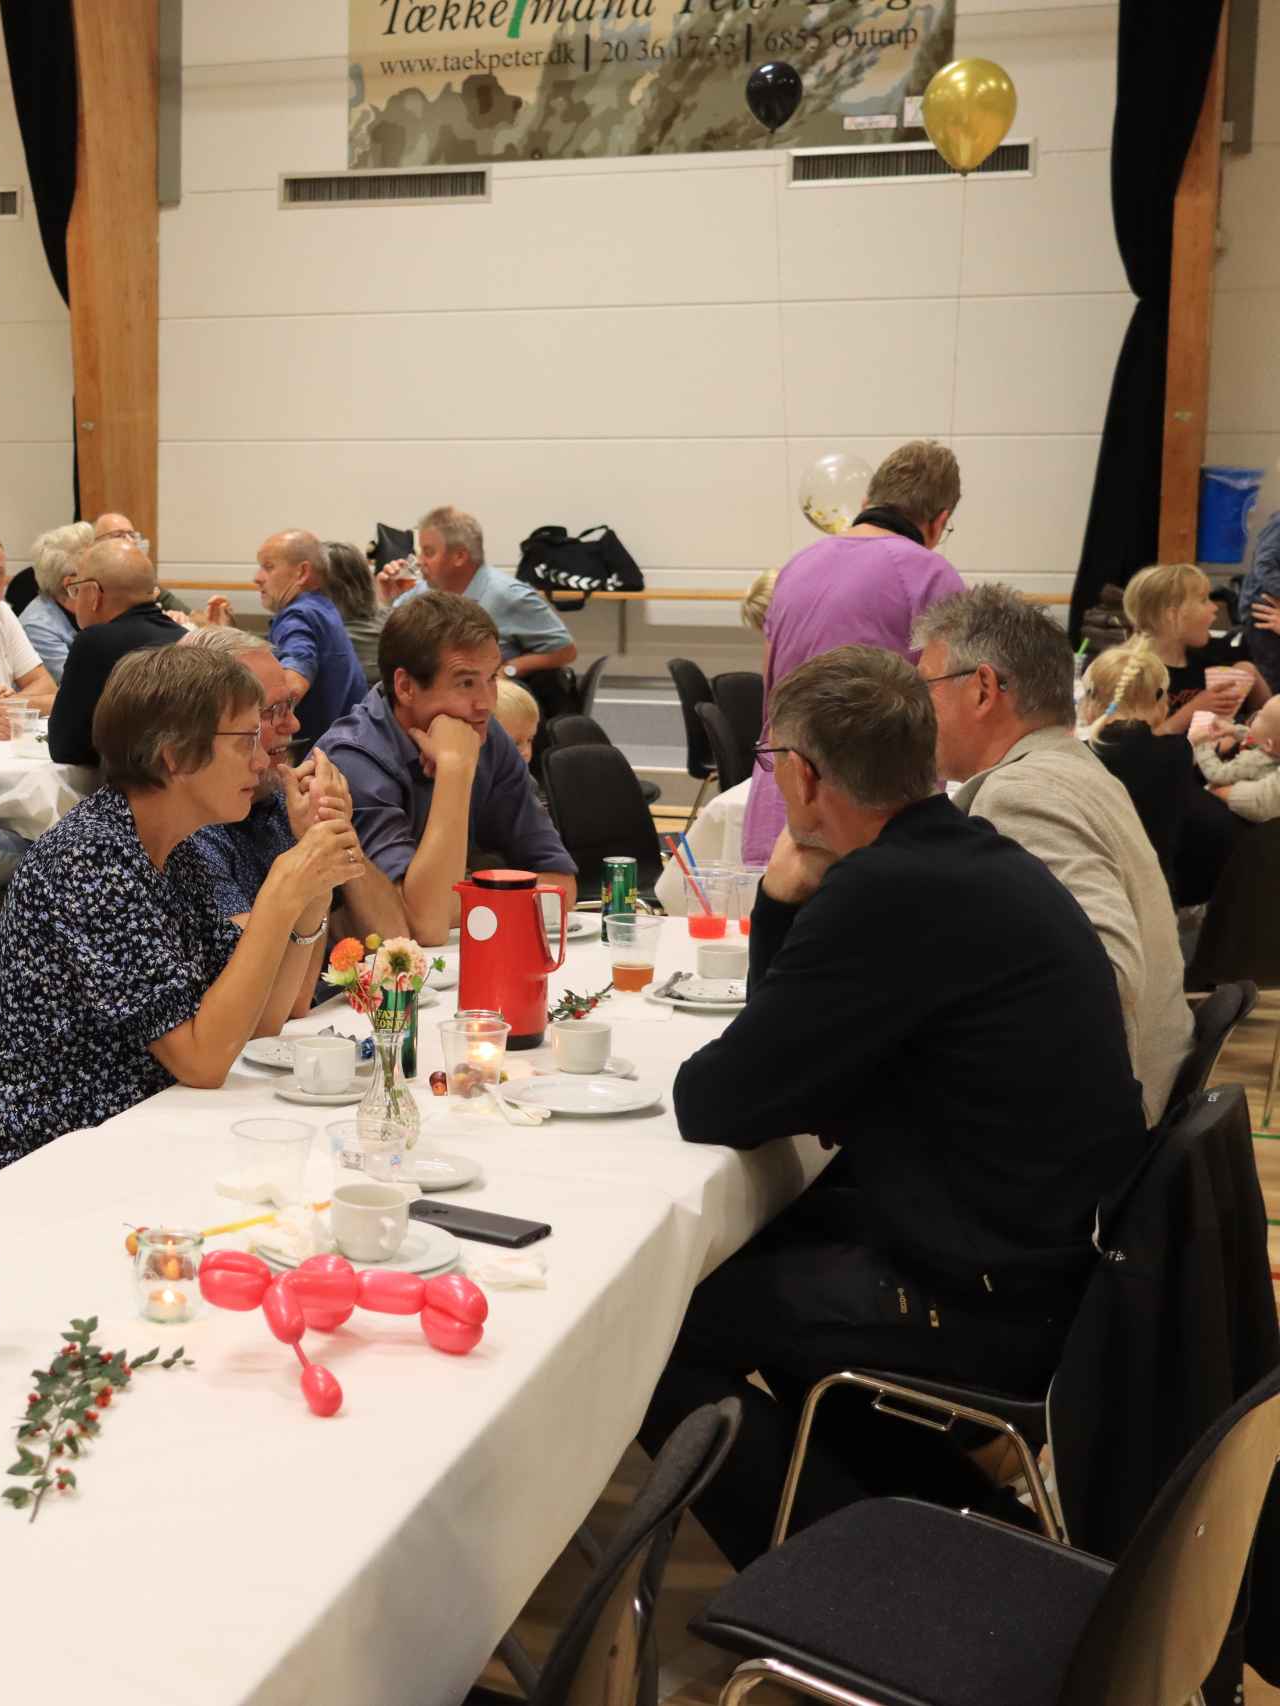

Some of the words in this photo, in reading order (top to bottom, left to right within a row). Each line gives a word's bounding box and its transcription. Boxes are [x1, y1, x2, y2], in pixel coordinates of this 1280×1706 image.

[379, 41, 576, 76] www.taekpeter.dk
[600, 40, 629, 64] 20
[636, 37, 666, 61] 36
